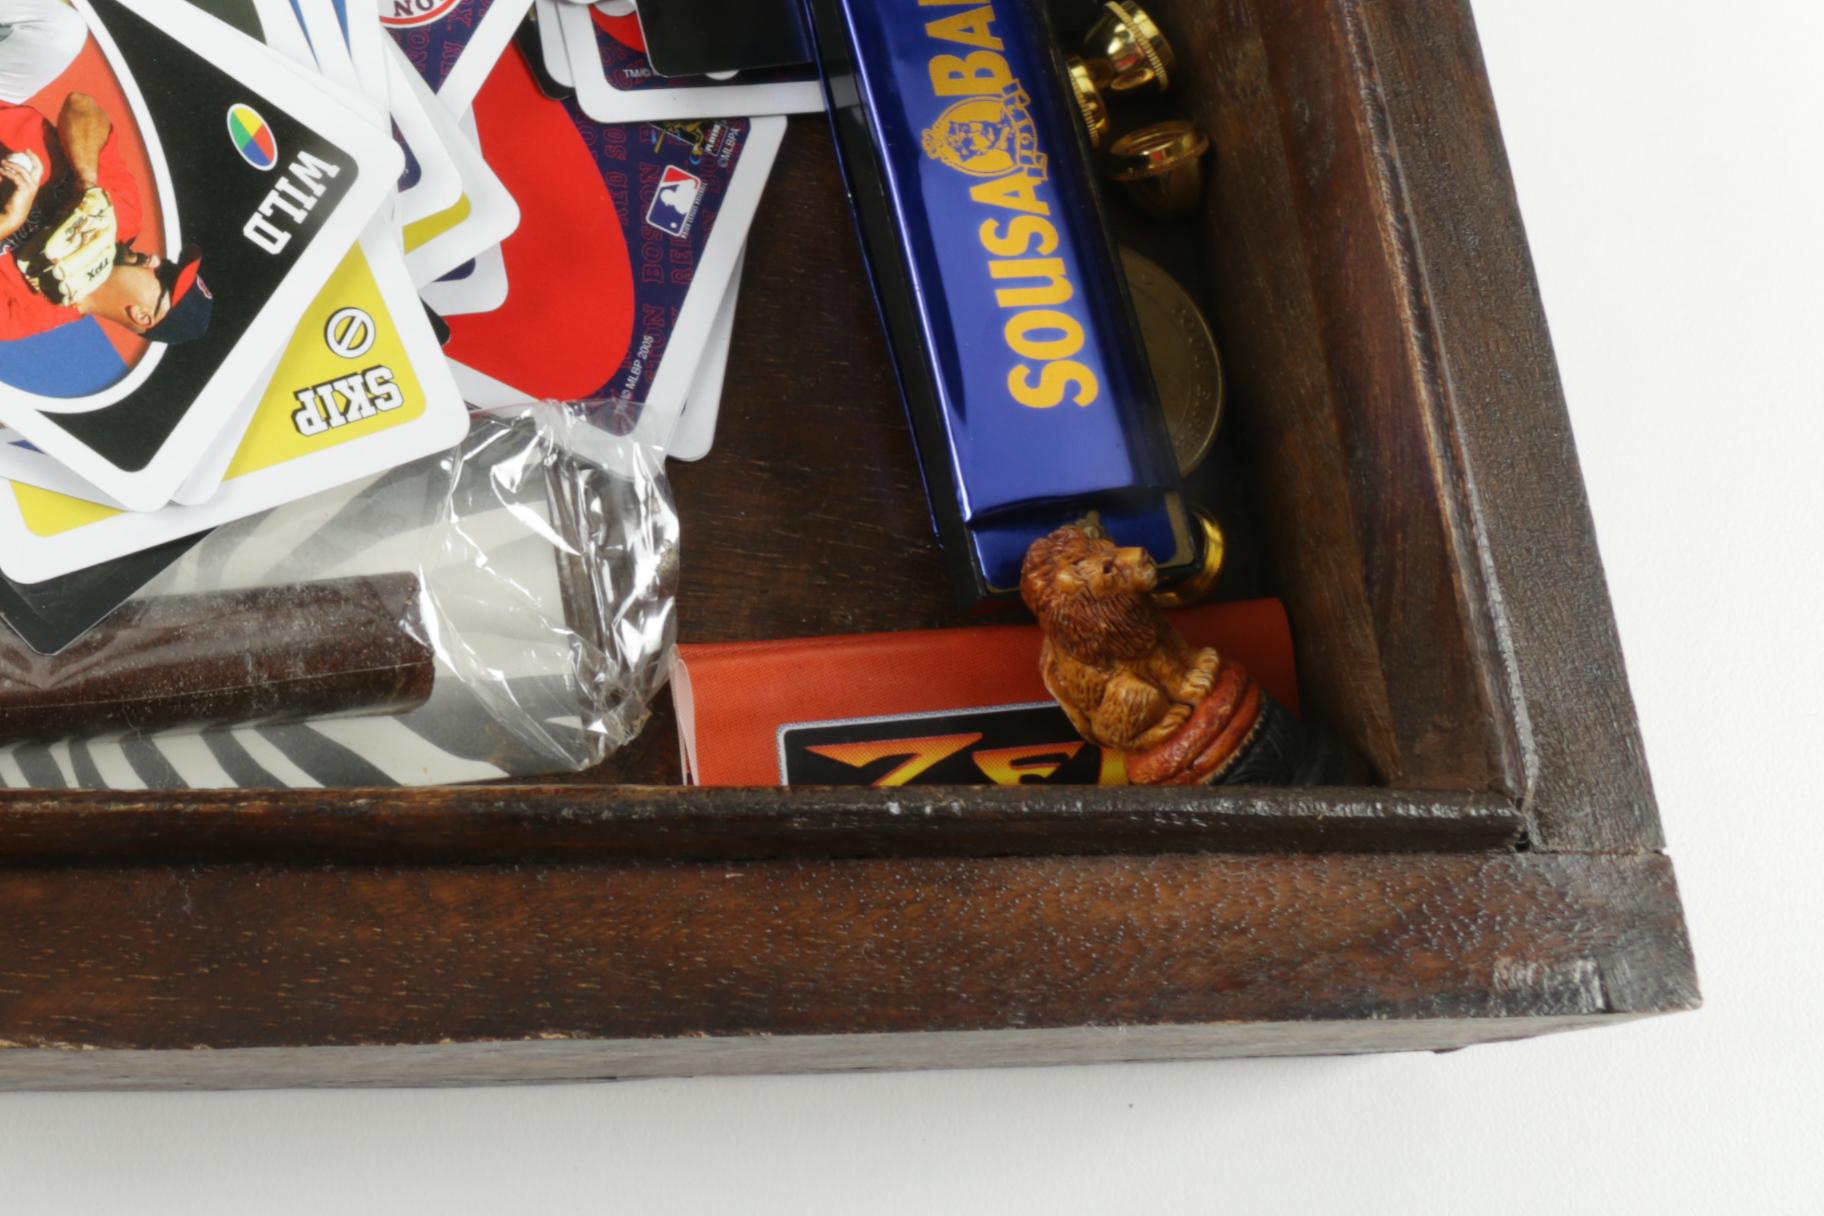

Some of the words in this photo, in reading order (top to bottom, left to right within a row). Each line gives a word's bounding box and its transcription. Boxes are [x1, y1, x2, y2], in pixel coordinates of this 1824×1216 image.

[242, 149, 341, 257] WILD
[969, 176, 1100, 410] SOUSA
[290, 363, 405, 438] SKIP
